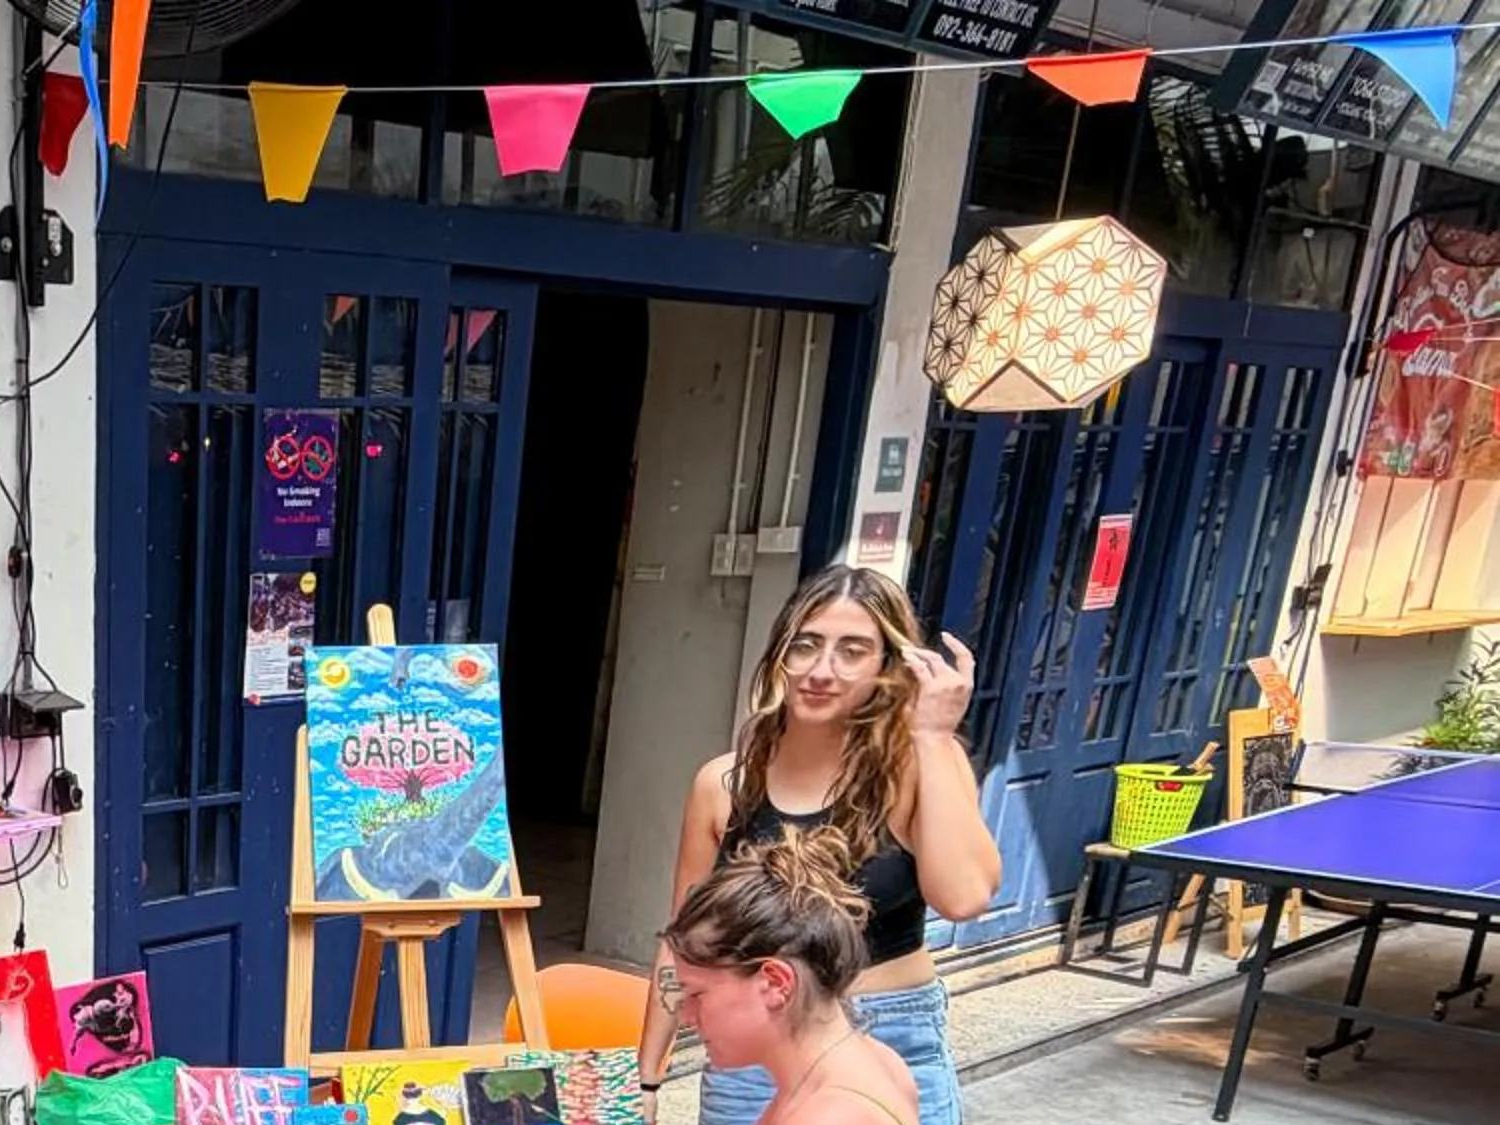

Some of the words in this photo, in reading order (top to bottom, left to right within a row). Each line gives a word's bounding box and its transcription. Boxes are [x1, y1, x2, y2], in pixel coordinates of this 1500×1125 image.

[289, 486, 321, 498] Smoking
[374, 709, 442, 734] THE
[341, 735, 476, 767] GARDEN
